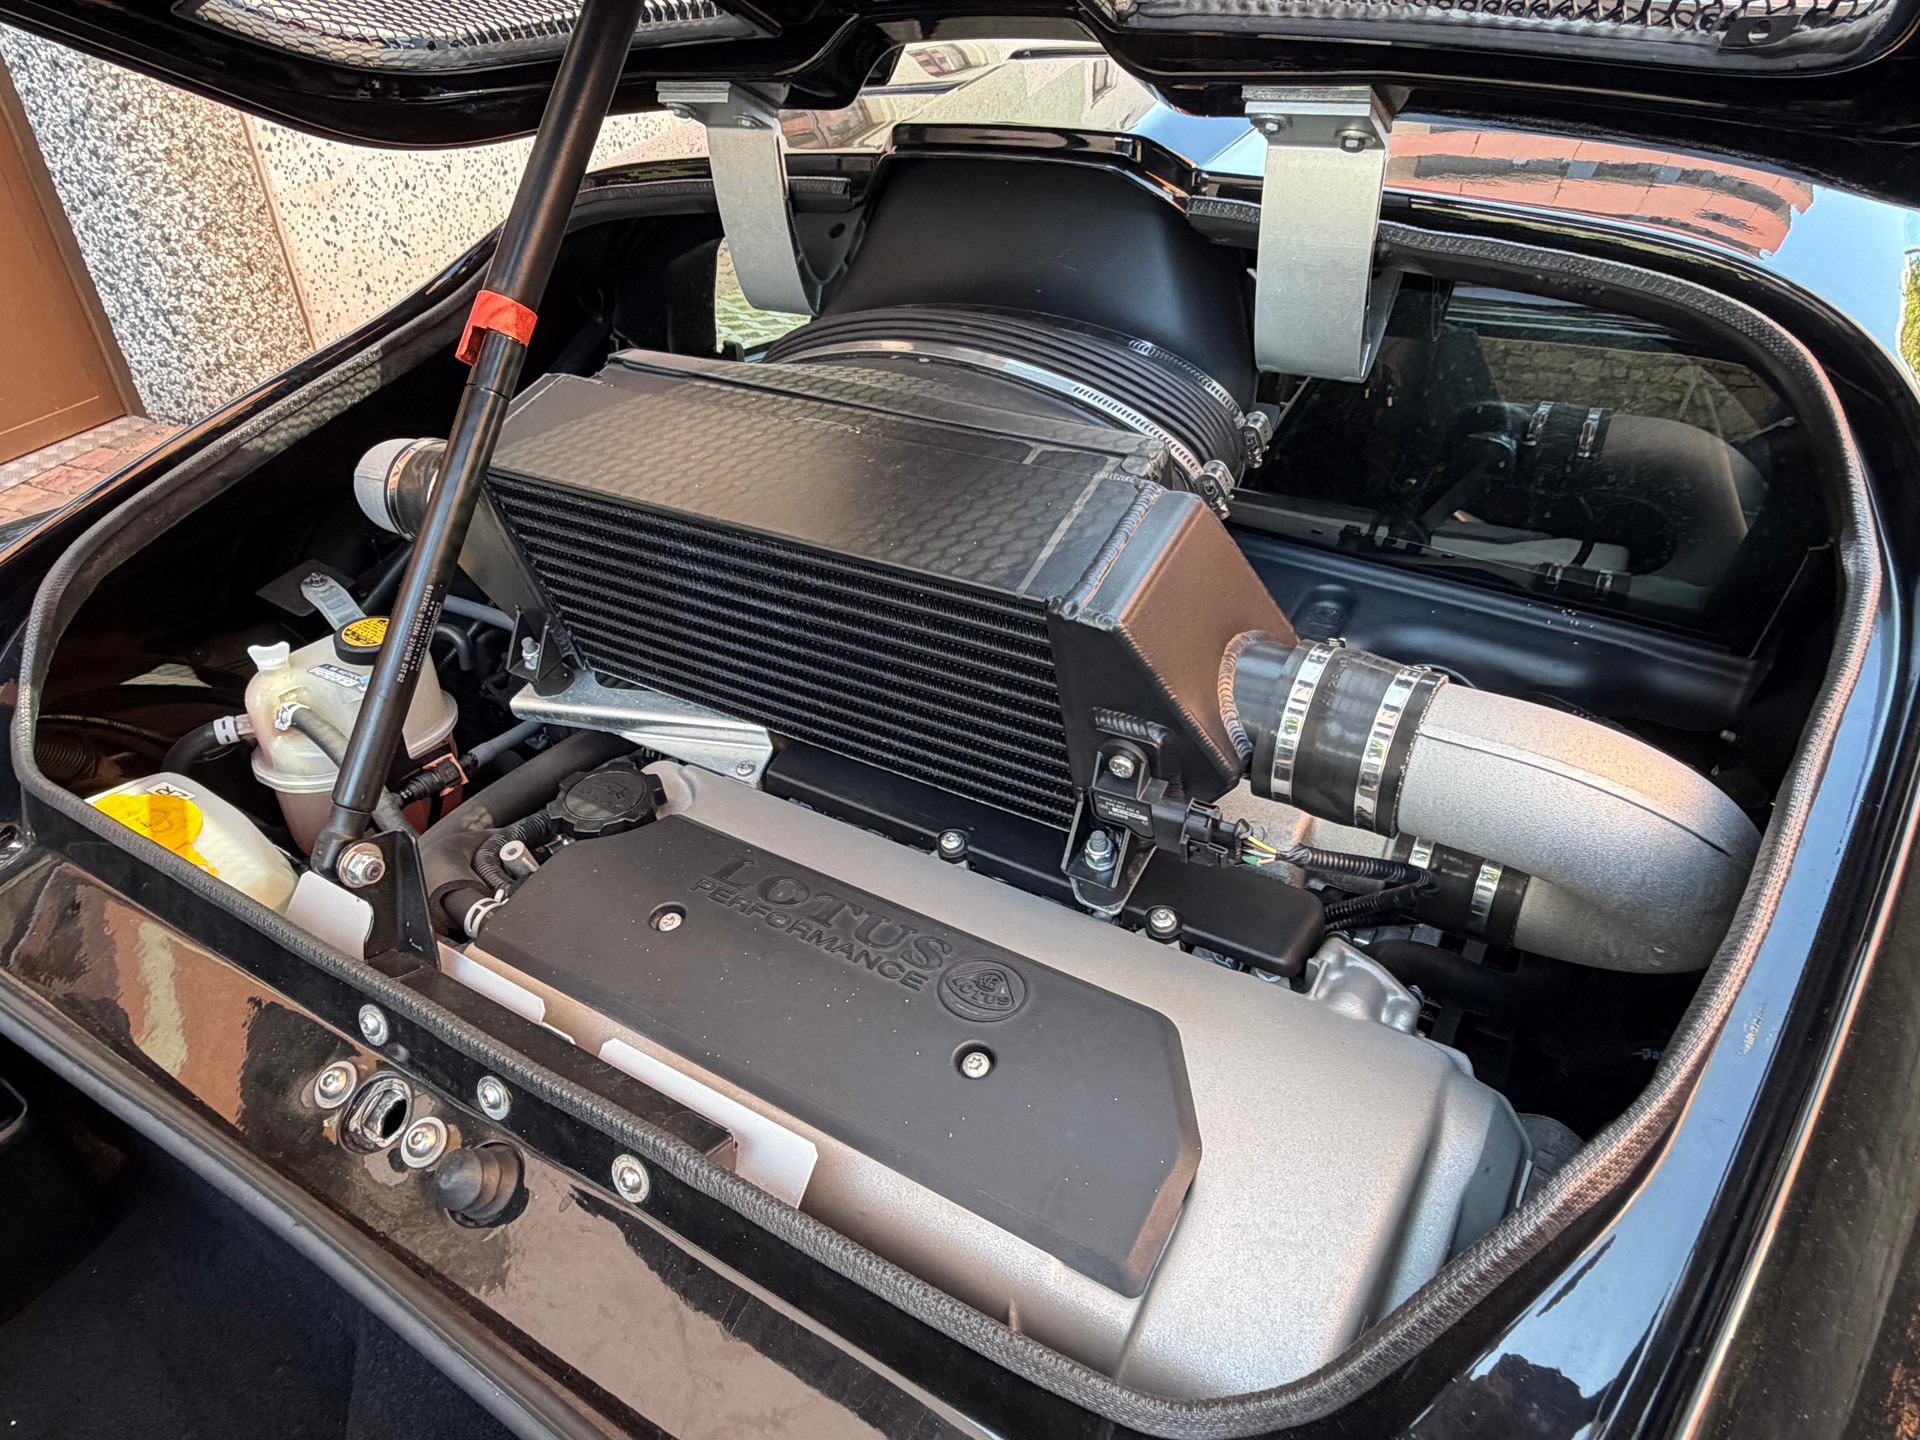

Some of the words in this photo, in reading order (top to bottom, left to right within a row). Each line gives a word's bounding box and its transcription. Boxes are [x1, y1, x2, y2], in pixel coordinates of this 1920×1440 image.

[690, 878, 930, 992] PERFORMANCE
[709, 854, 953, 971] LOTUS
[951, 979, 1010, 1006] LOTUS
